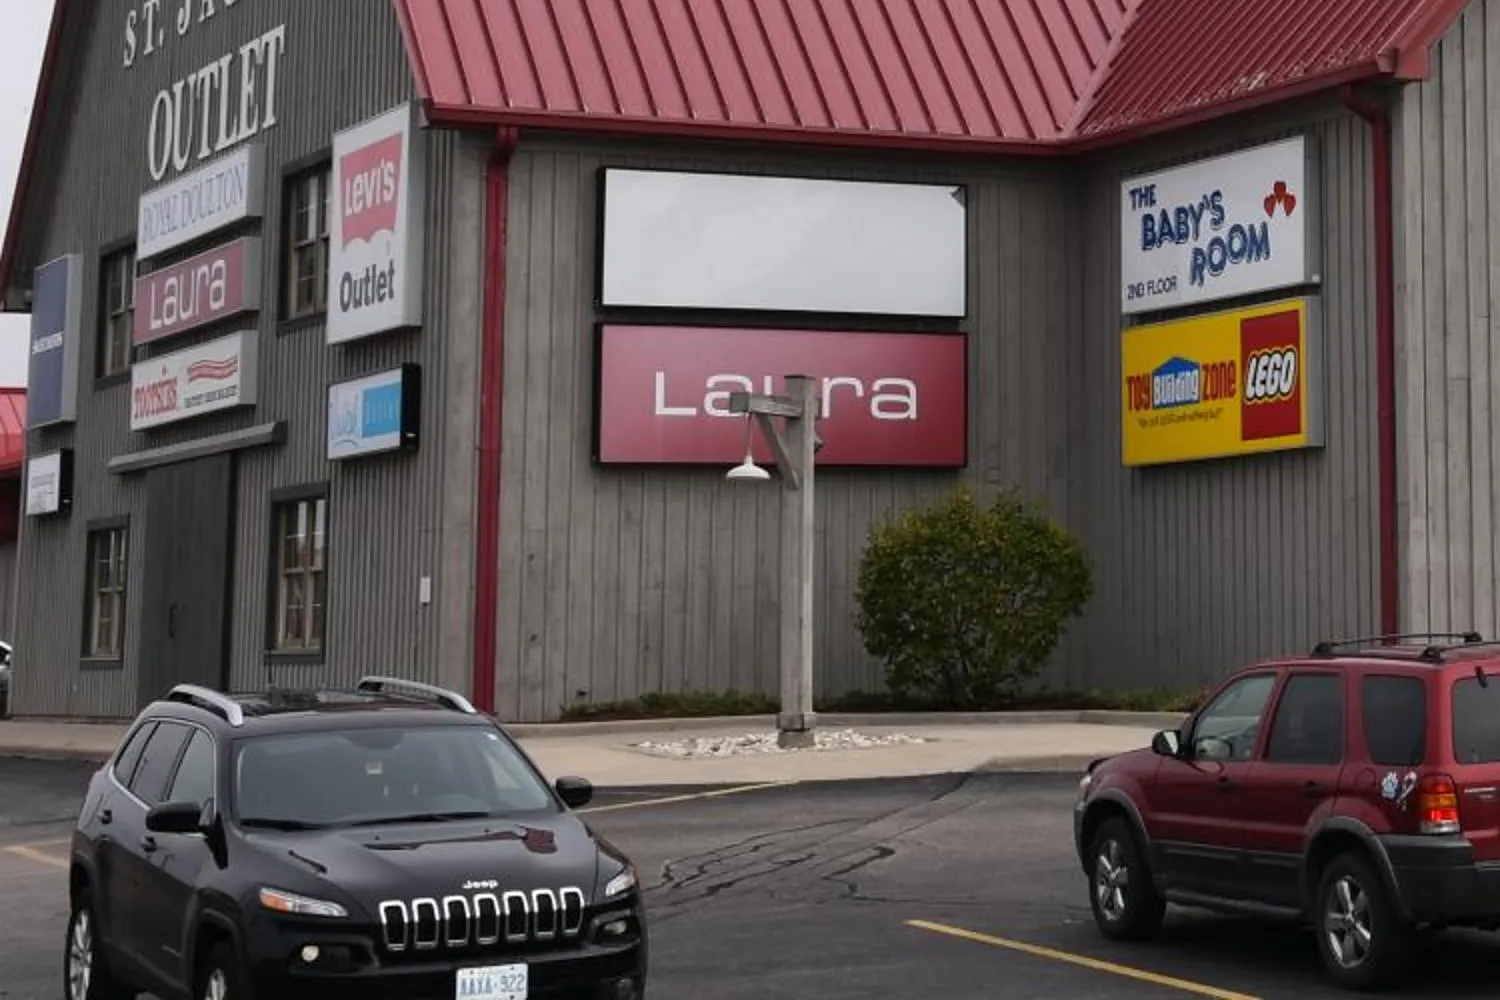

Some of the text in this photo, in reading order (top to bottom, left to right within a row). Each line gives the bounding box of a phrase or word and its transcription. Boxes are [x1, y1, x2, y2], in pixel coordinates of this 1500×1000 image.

[149, 24, 286, 181] OUTLET
[1128, 183, 1157, 210] THE
[1141, 189, 1225, 252] BABY'S
[1189, 221, 1271, 287] ROOM
[150, 259, 226, 329] Laura
[340, 260, 396, 312] Outlet
[1147, 275, 1178, 296] FLOOR
[655, 371, 918, 420] Lara
[1245, 348, 1297, 401] LEGO
[462, 880, 499, 889] Jeep
